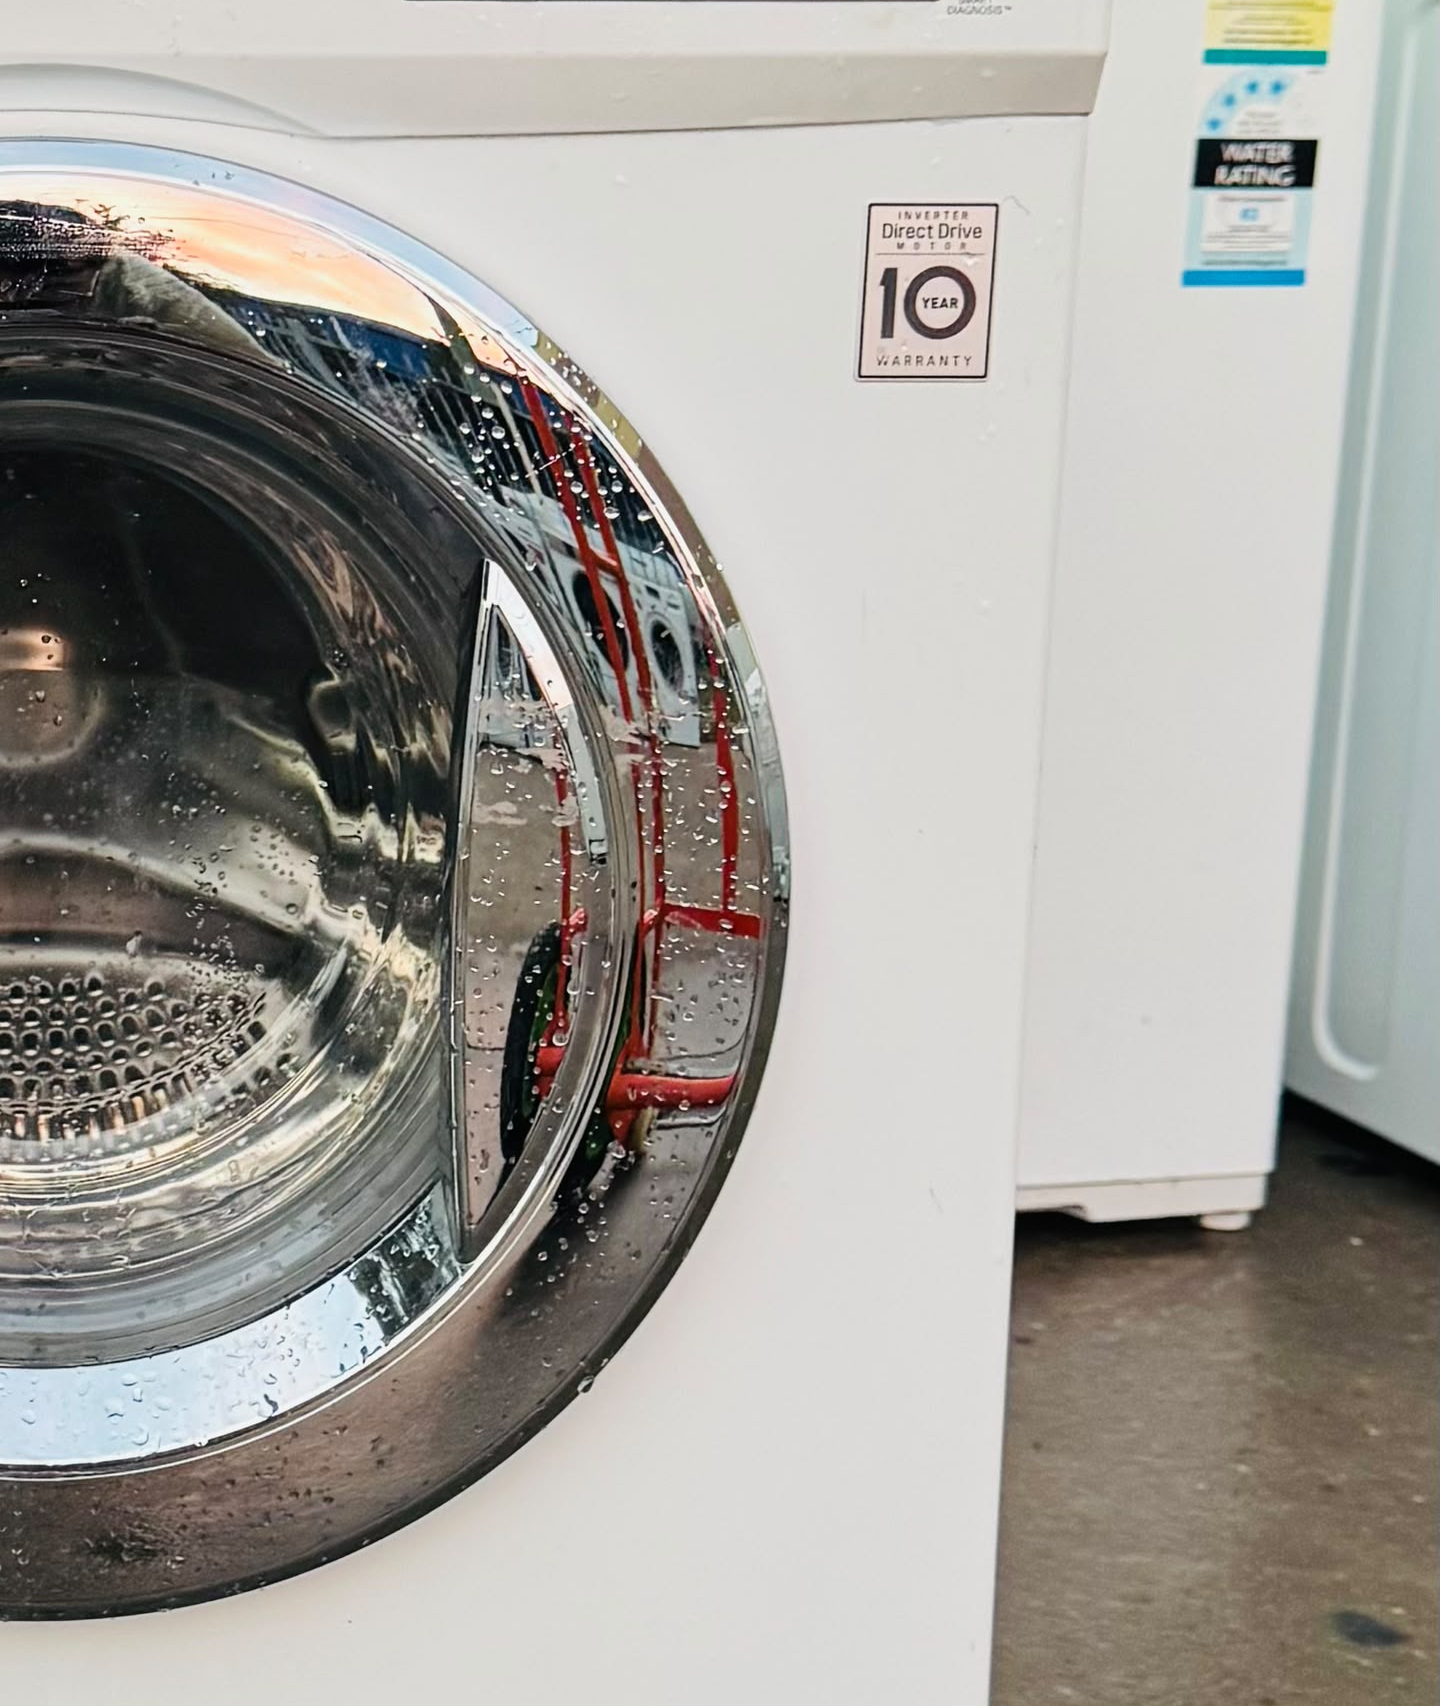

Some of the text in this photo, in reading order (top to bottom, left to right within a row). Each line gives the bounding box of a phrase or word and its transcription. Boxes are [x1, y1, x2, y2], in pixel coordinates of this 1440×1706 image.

[1220, 141, 1295, 163] WATER
[1214, 164, 1296, 187] RATING
[898, 211, 969, 221] INVERTER
[882, 223, 983, 239] Direct Drive
[896, 242, 967, 250] MOTOR
[879, 265, 977, 340] 10
[922, 297, 959, 309] YEAR
[876, 355, 973, 367] WARRANTY
